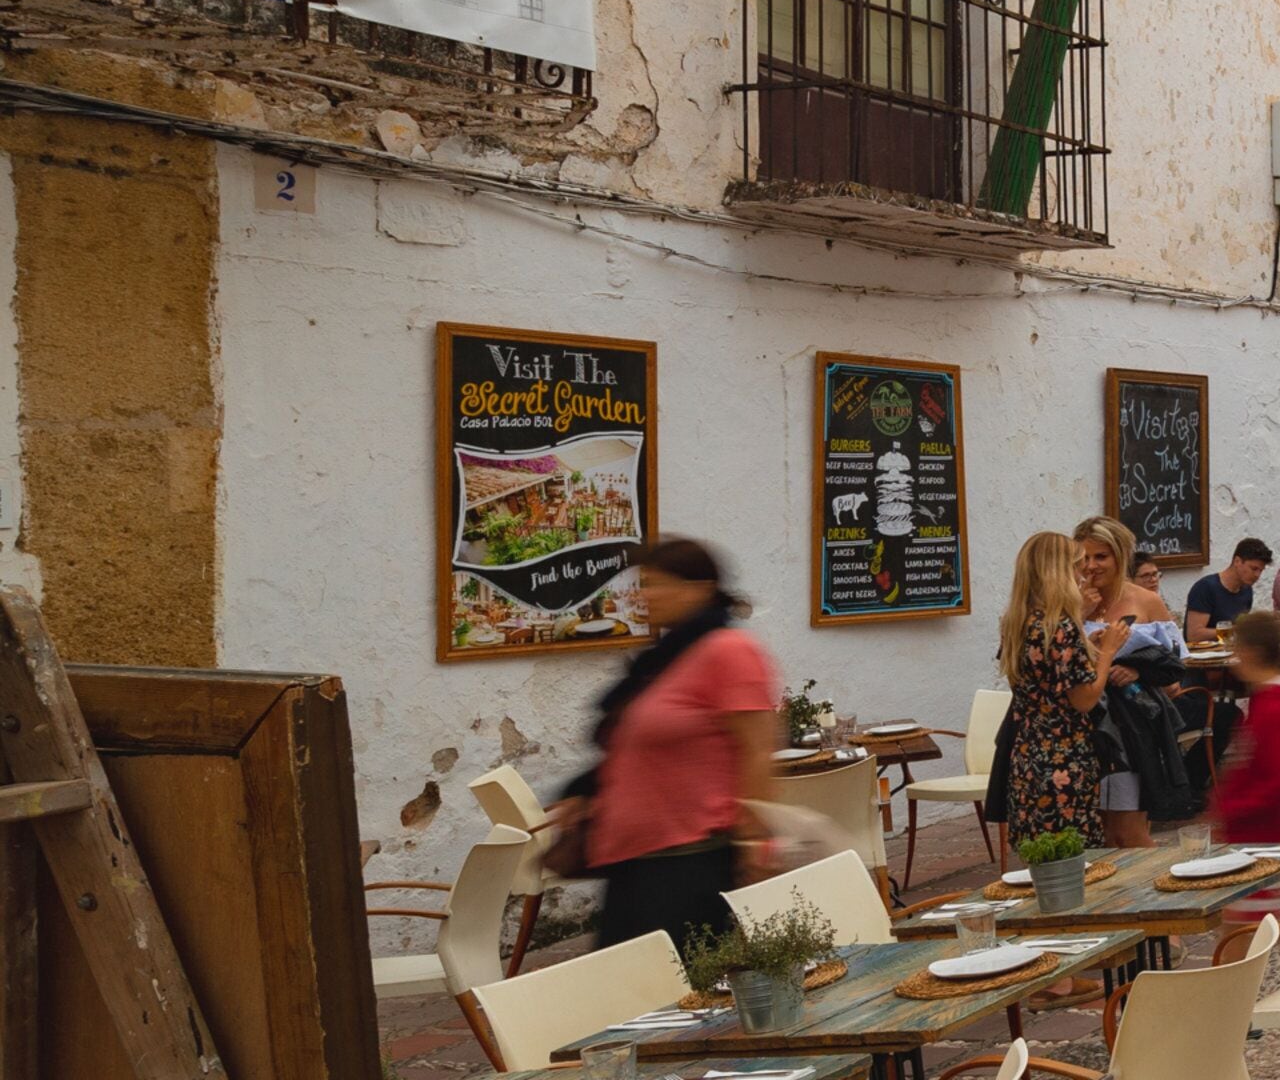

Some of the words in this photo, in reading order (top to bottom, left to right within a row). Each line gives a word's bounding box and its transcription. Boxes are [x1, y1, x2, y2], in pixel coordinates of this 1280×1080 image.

[276, 171, 296, 201] 2
[486, 344, 554, 380] Visit
[563, 349, 618, 385] The
[459, 380, 549, 416] Secret
[554, 381, 645, 433] Garden
[460, 416, 489, 429] Casa
[492, 413, 532, 429] Palacio
[1129, 398, 1181, 440] Visit
[830, 439, 871, 452] BURGERS
[920, 442, 951, 455] PAELLA
[1154, 445, 1181, 471] The
[826, 462, 841, 470] BEEF
[843, 462, 874, 470] BURGERS
[918, 463, 945, 471] CHICKEN
[825, 476, 867, 484] VEGETARIAN
[918, 477, 945, 485] SEAFOOD
[1132, 462, 1186, 504] Secret
[919, 493, 957, 501] VEGETARIAN
[1144, 504, 1192, 537] Garden
[827, 527, 867, 540] DRINKS
[920, 526, 952, 537] MENUS
[832, 549, 855, 557] JUICES
[905, 546, 935, 555] FARMERS
[936, 545, 957, 553] MENU
[832, 562, 869, 571] COCKTAILS
[924, 559, 944, 567] MENU
[530, 569, 559, 591] Find
[562, 560, 583, 580] the
[833, 575, 873, 585] SMOOTHIES
[906, 573, 919, 581] FISH
[921, 572, 942, 580] MENU
[832, 591, 854, 600] CRAFT
[856, 589, 877, 598] BEERS
[941, 585, 961, 593] MENU
